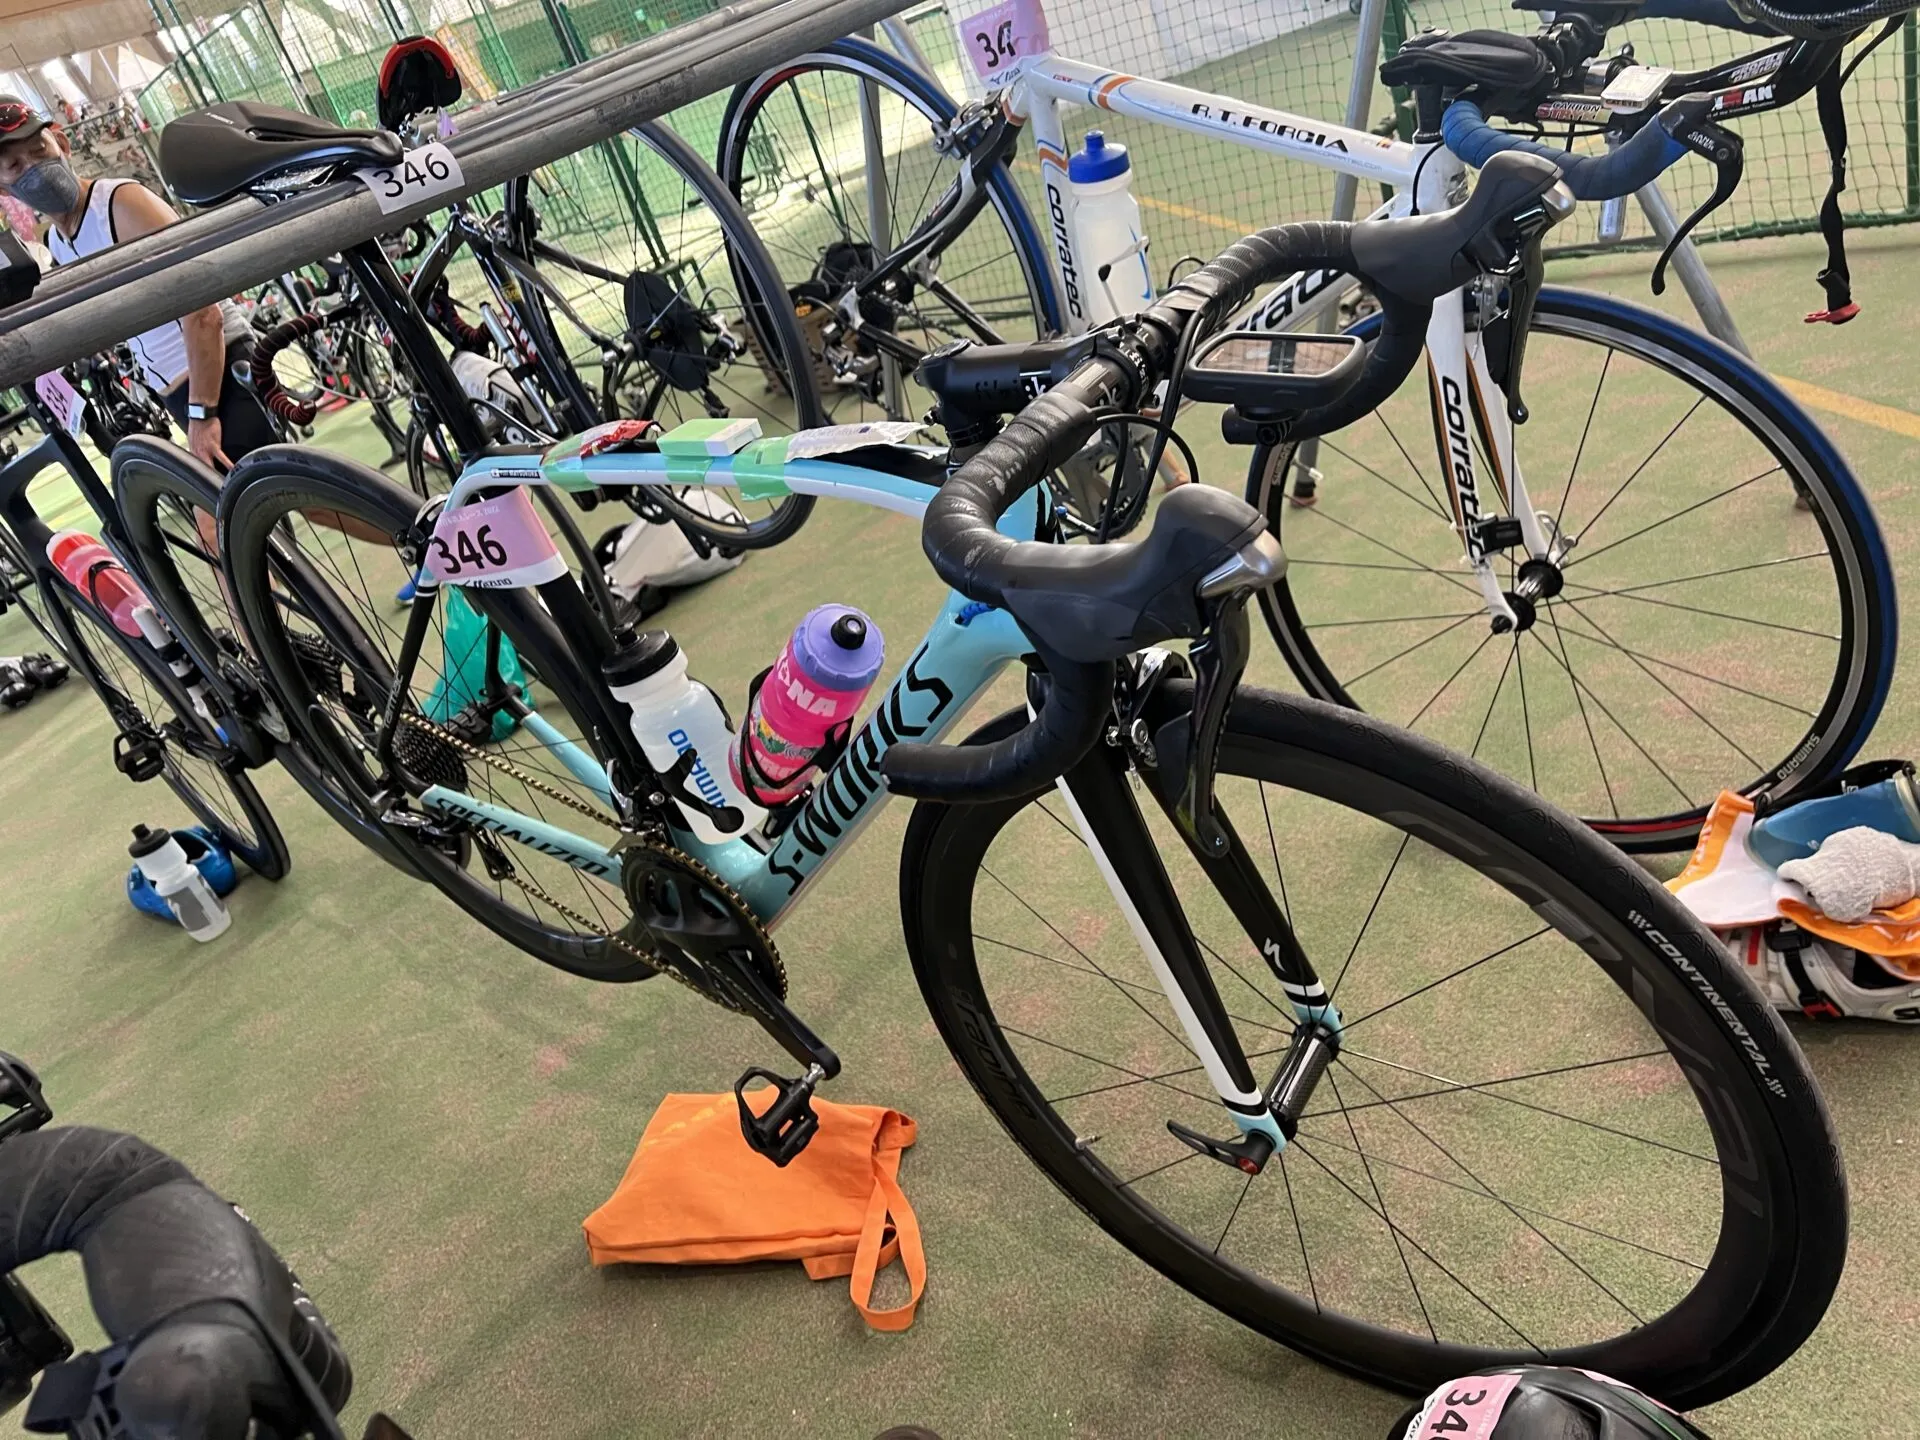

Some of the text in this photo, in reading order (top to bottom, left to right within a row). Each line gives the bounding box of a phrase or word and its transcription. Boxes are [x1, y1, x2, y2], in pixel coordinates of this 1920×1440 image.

[373, 153, 449, 198] 346
[1047, 183, 1082, 319] corratec
[431, 524, 507, 574] 346
[769, 642, 953, 896] S-WORKS
[1776, 733, 1820, 780] SHIMANO
[436, 797, 610, 876] SPECIALIZED
[1645, 927, 1771, 1076] CONTINENTAL
[1428, 1389, 1487, 1440] 34
